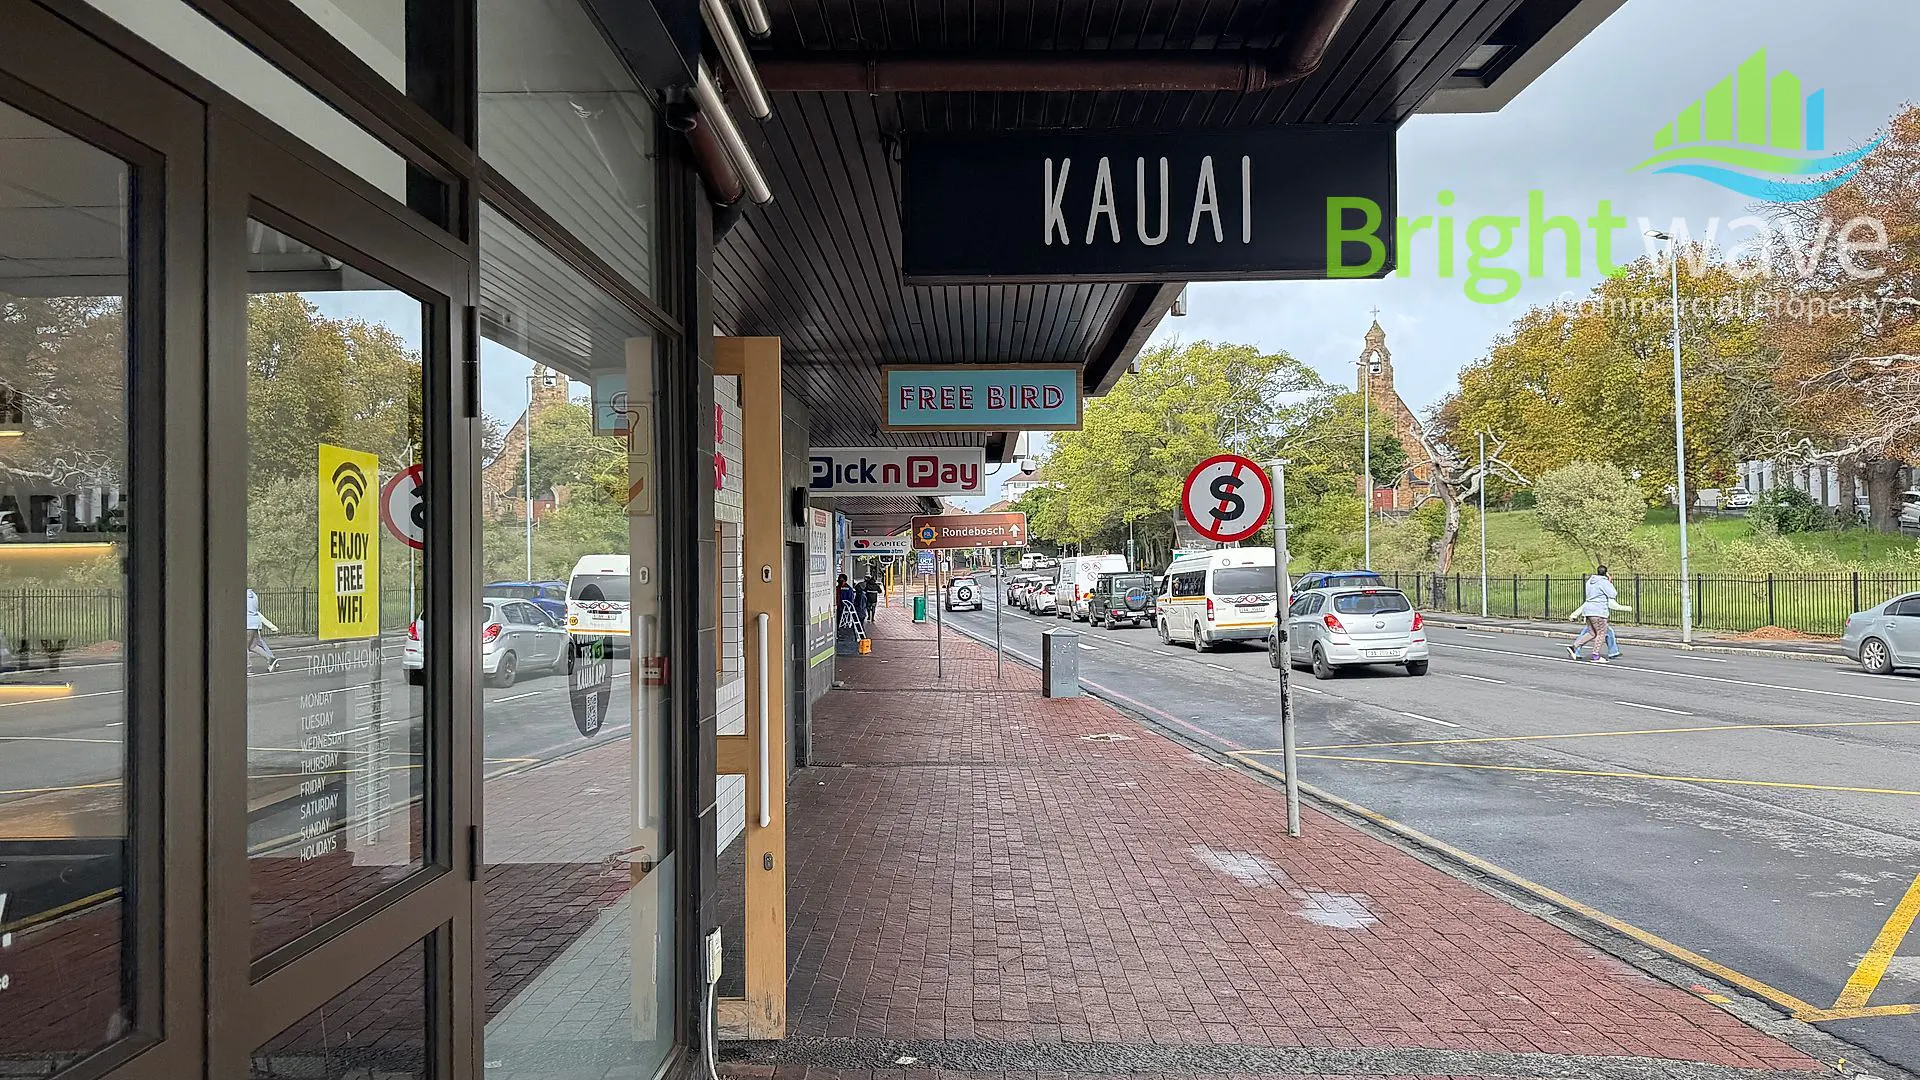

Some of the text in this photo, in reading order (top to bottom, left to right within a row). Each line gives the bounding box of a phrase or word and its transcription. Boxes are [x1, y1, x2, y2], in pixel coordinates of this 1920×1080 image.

[1045, 155, 1251, 246] KAUAI
[900, 385, 1065, 410] FREE BIRD
[809, 455, 978, 490] Pick n Pay
[1209, 475, 1245, 521] S
[942, 526, 1005, 538] Rondebosch
[330, 530, 369, 561] ENJOY
[890, 547, 904, 555] atm
[336, 564, 363, 593] FREE
[336, 595, 363, 624] WIFI
[307, 647, 387, 676] TRADING HOURS
[300, 691, 333, 709] MONDAY
[301, 711, 334, 730] TUESDAY
[301, 732, 345, 750] WEDNESDAY
[301, 751, 339, 774] THURSDAY
[300, 776, 327, 798] FRIDAY
[300, 792, 339, 820] SATURDAY
[301, 817, 330, 841] SUNDAY
[300, 835, 337, 863] HOLIDAYS
